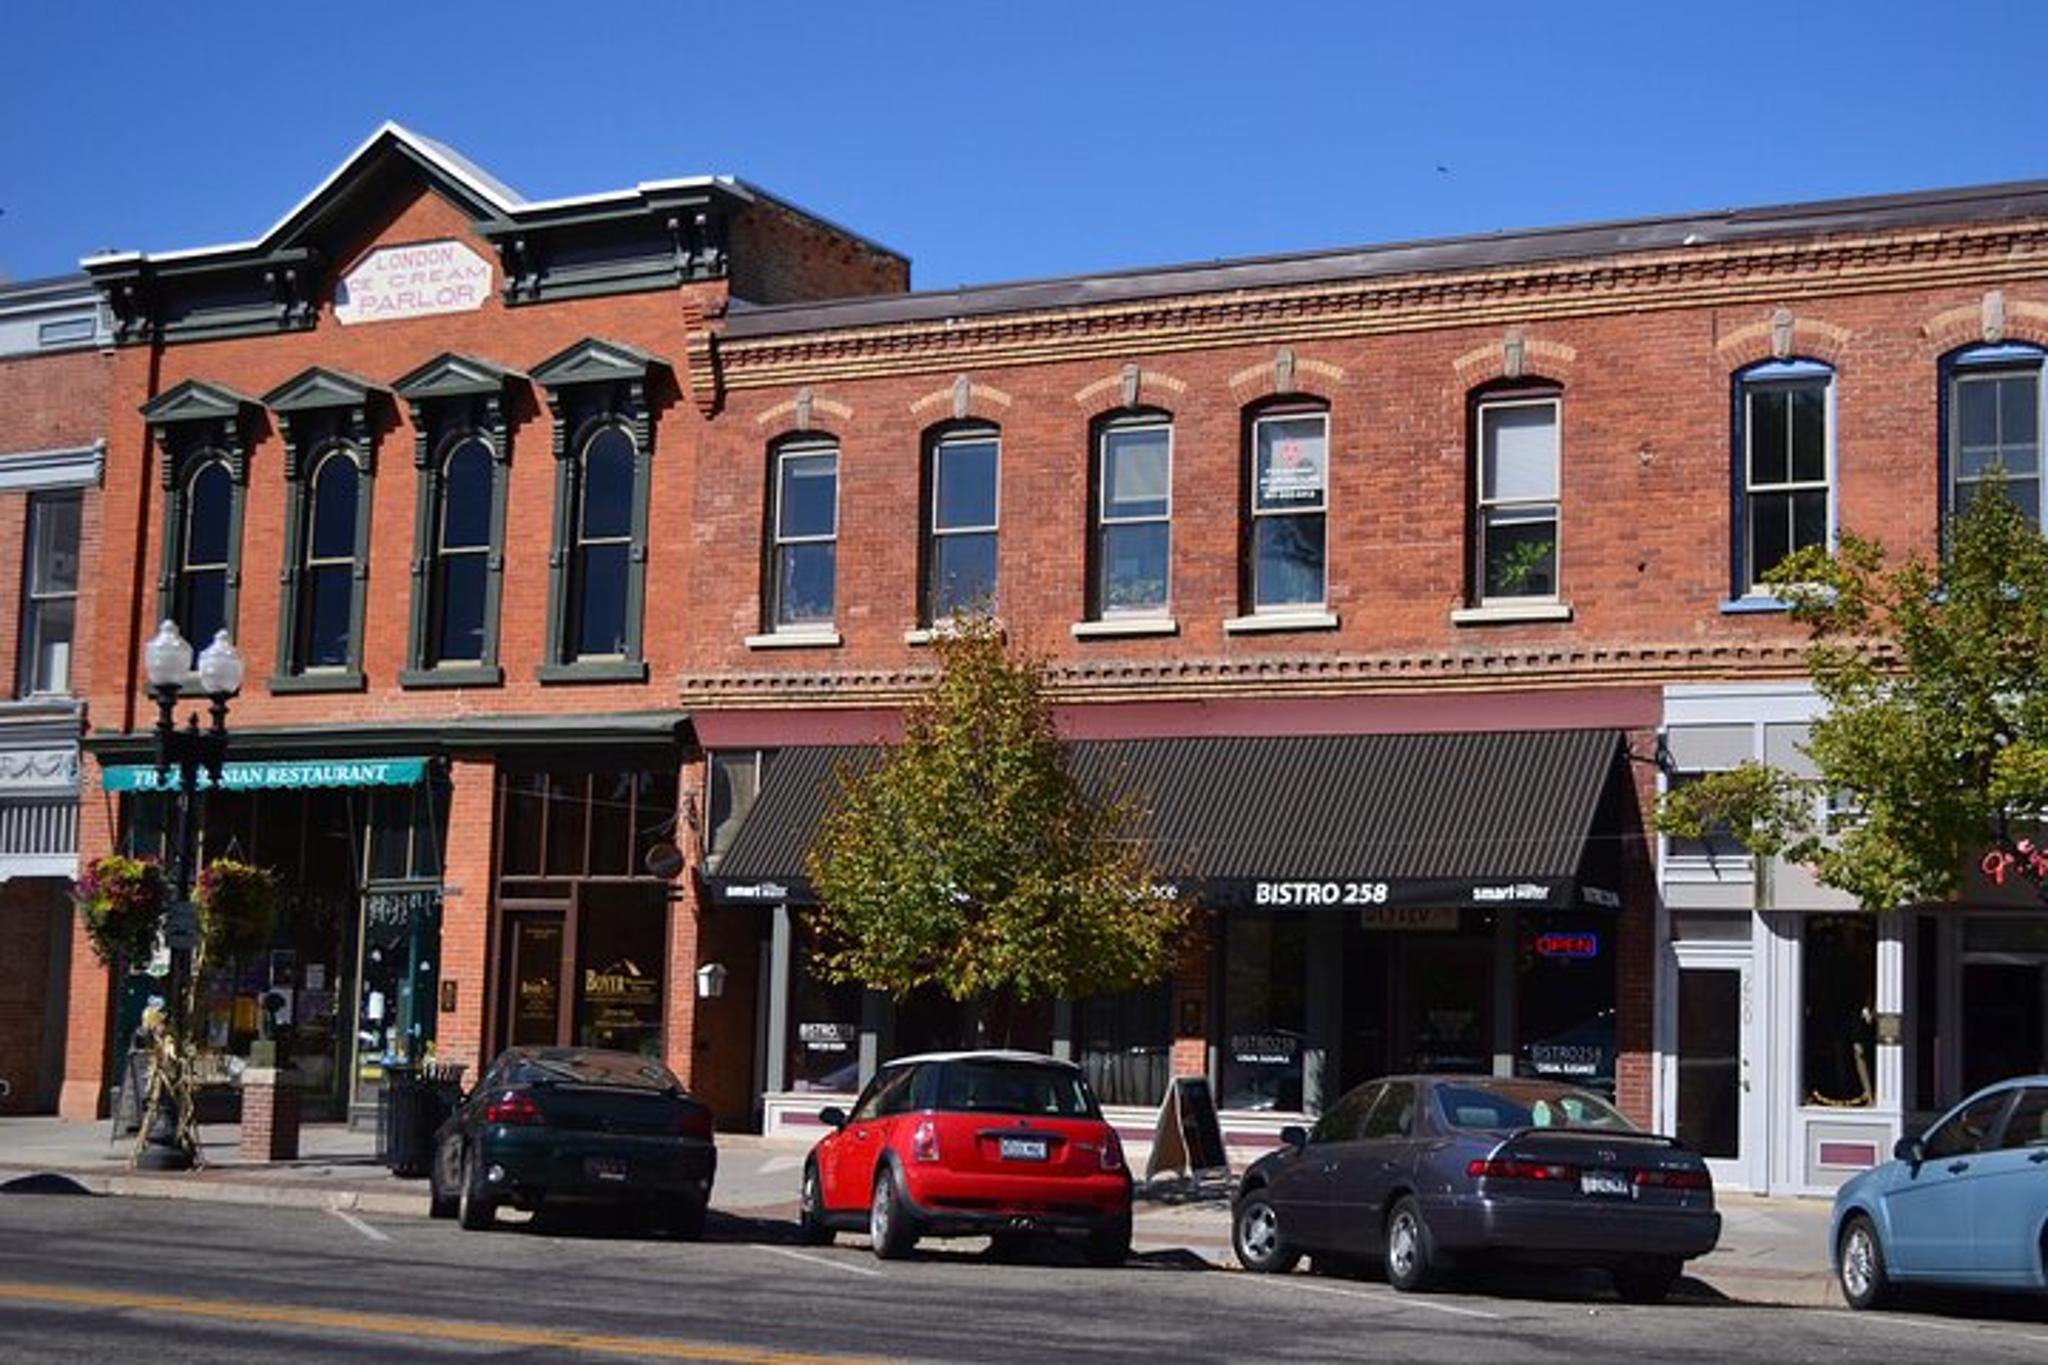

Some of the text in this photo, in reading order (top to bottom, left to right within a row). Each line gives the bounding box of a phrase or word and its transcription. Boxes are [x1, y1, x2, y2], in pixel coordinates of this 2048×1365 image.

[376, 248, 453, 271] LONDON
[387, 264, 488, 289] CREAM
[358, 285, 476, 316] PARLOR
[134, 769, 164, 787] TH
[265, 763, 390, 783] RESTAURANT
[1256, 882, 1389, 904] BISTRO 258
[1536, 937, 1593, 954] OPEN
